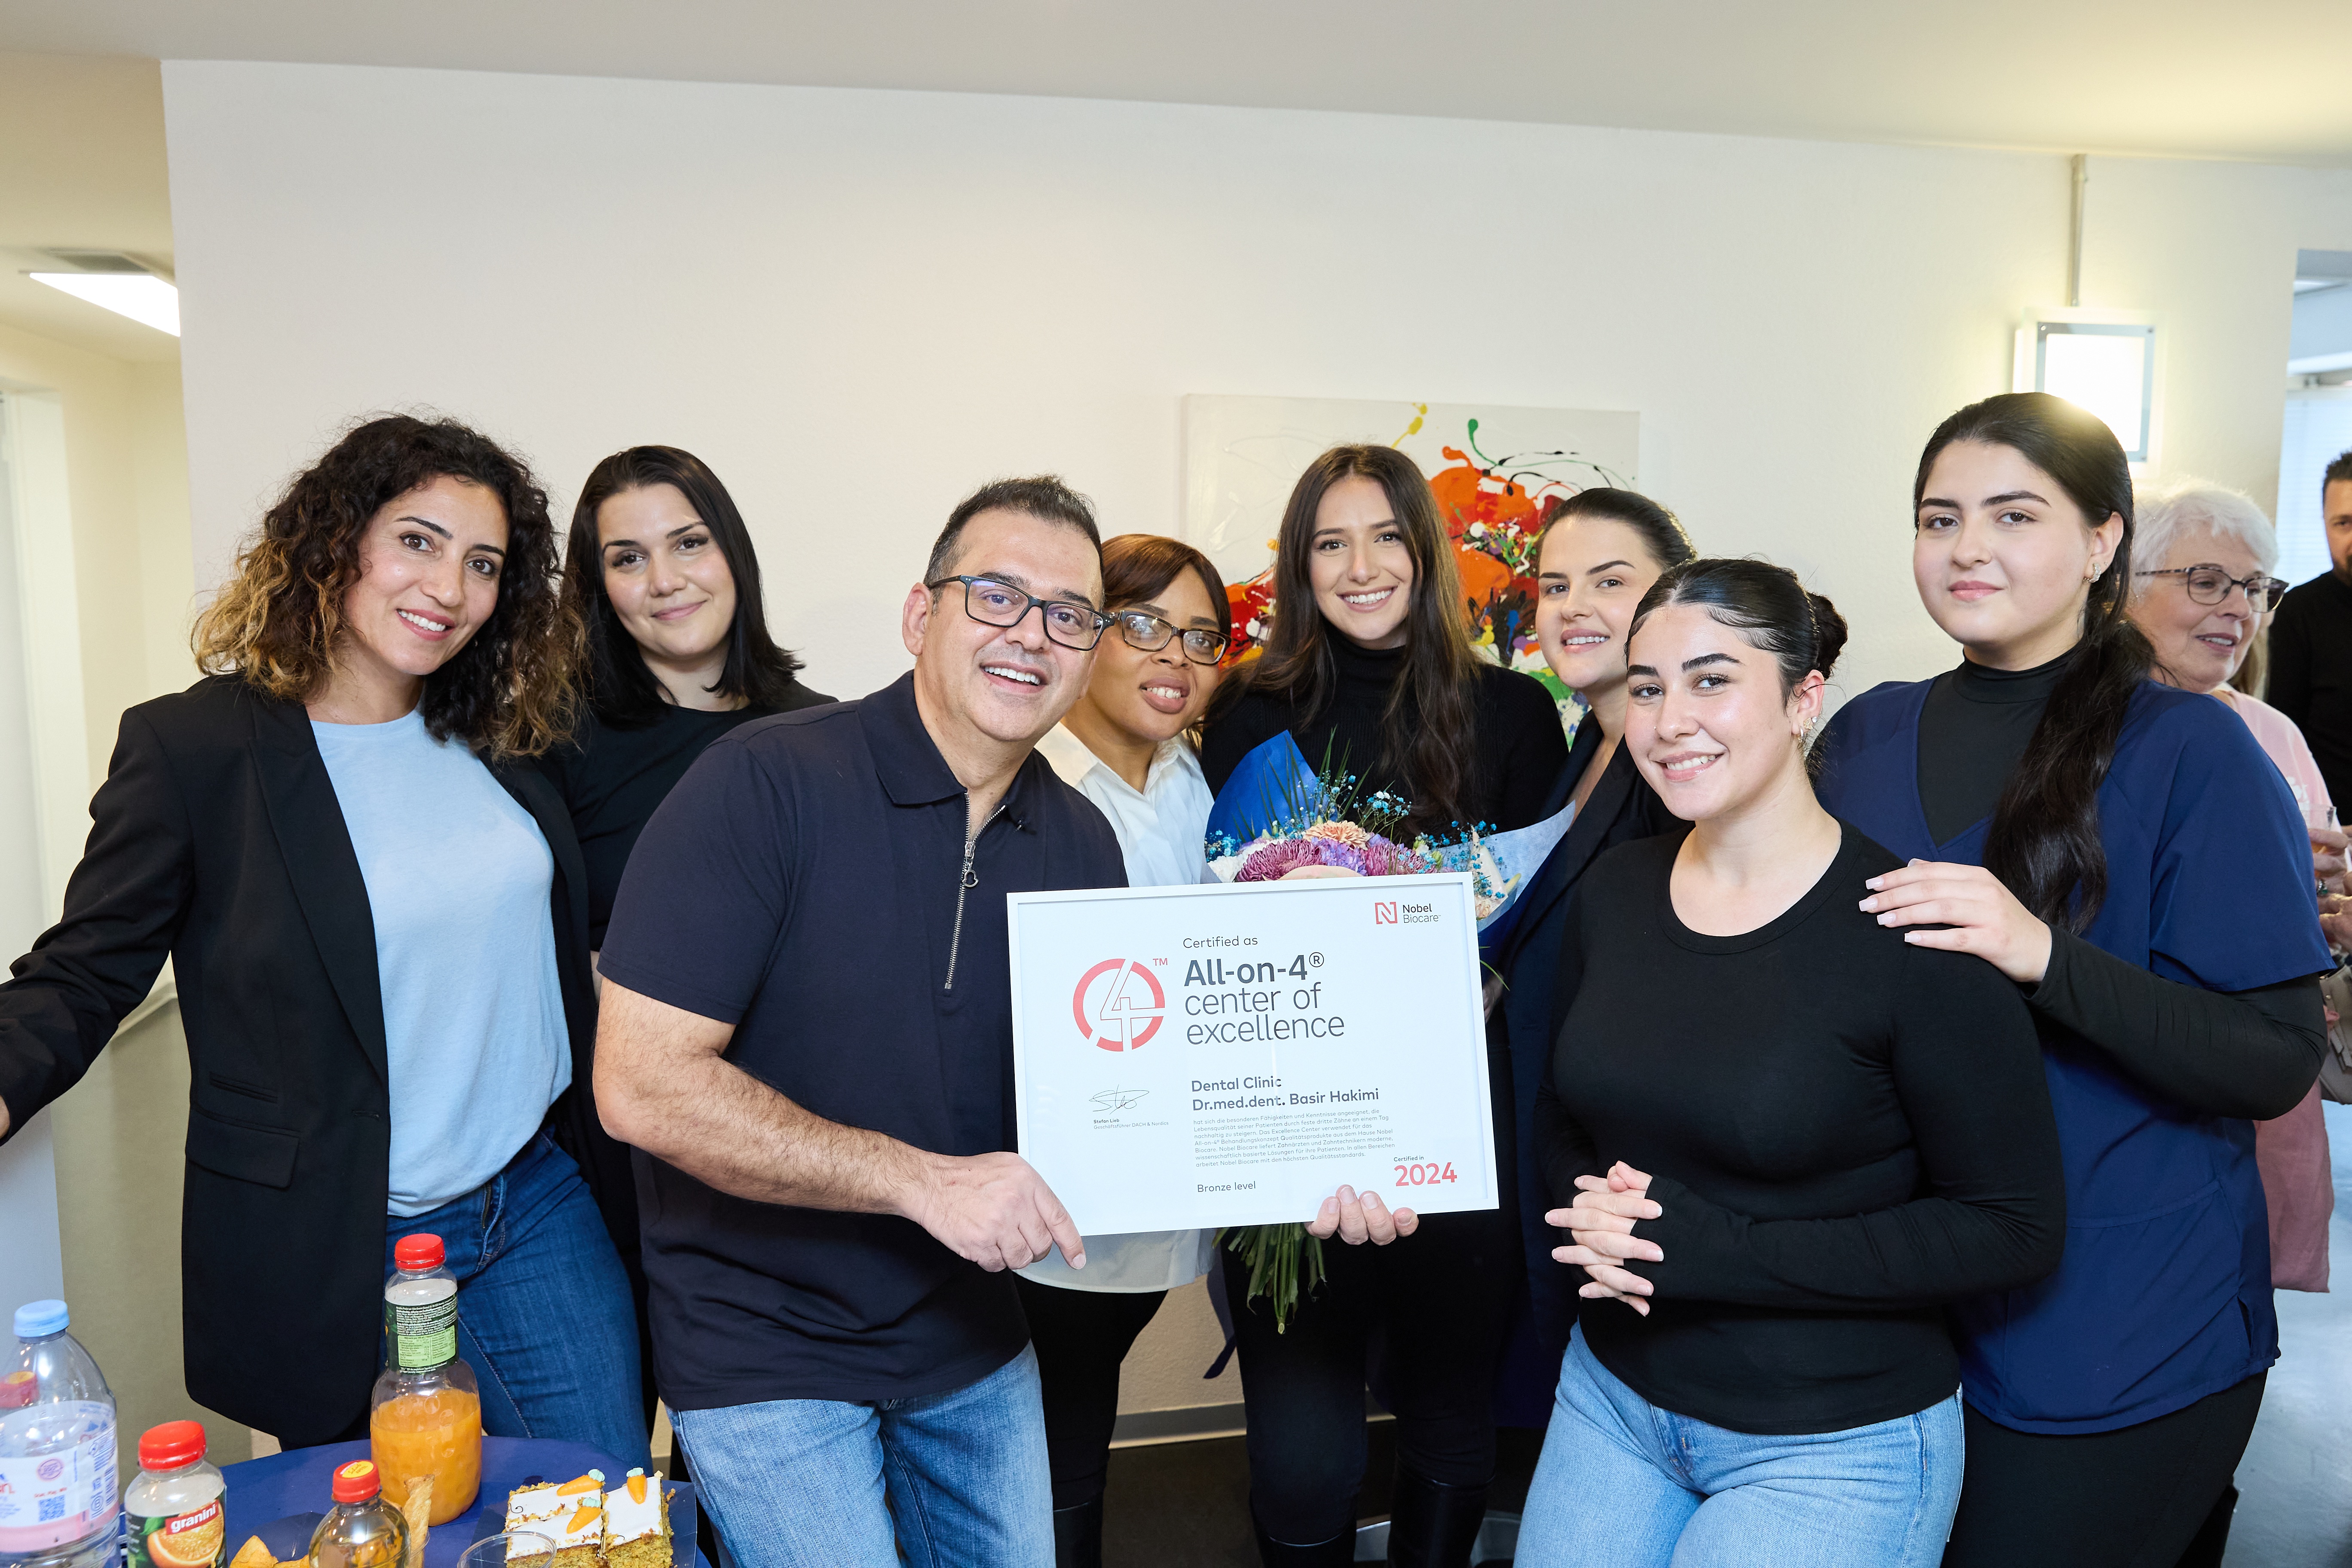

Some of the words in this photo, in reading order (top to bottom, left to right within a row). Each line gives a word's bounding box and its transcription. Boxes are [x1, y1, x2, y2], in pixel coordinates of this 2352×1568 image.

[1403, 903, 1432, 913] Nobel
[1183, 935, 1239, 948] Certified
[1185, 988, 1281, 1015] center
[1293, 982, 1321, 1009] of
[1187, 1014, 1344, 1044] excellence
[1191, 1078, 1239, 1092] Dental
[1243, 1076, 1282, 1088] Clinic
[1193, 1096, 1285, 1111] Dr.med.dent.
[1290, 1092, 1325, 1105] Basir
[1330, 1088, 1378, 1102] Hakimi
[1235, 1181, 1256, 1190] level
[1394, 1162, 1457, 1186] 2024
[171, 1504, 216, 1534] granini
